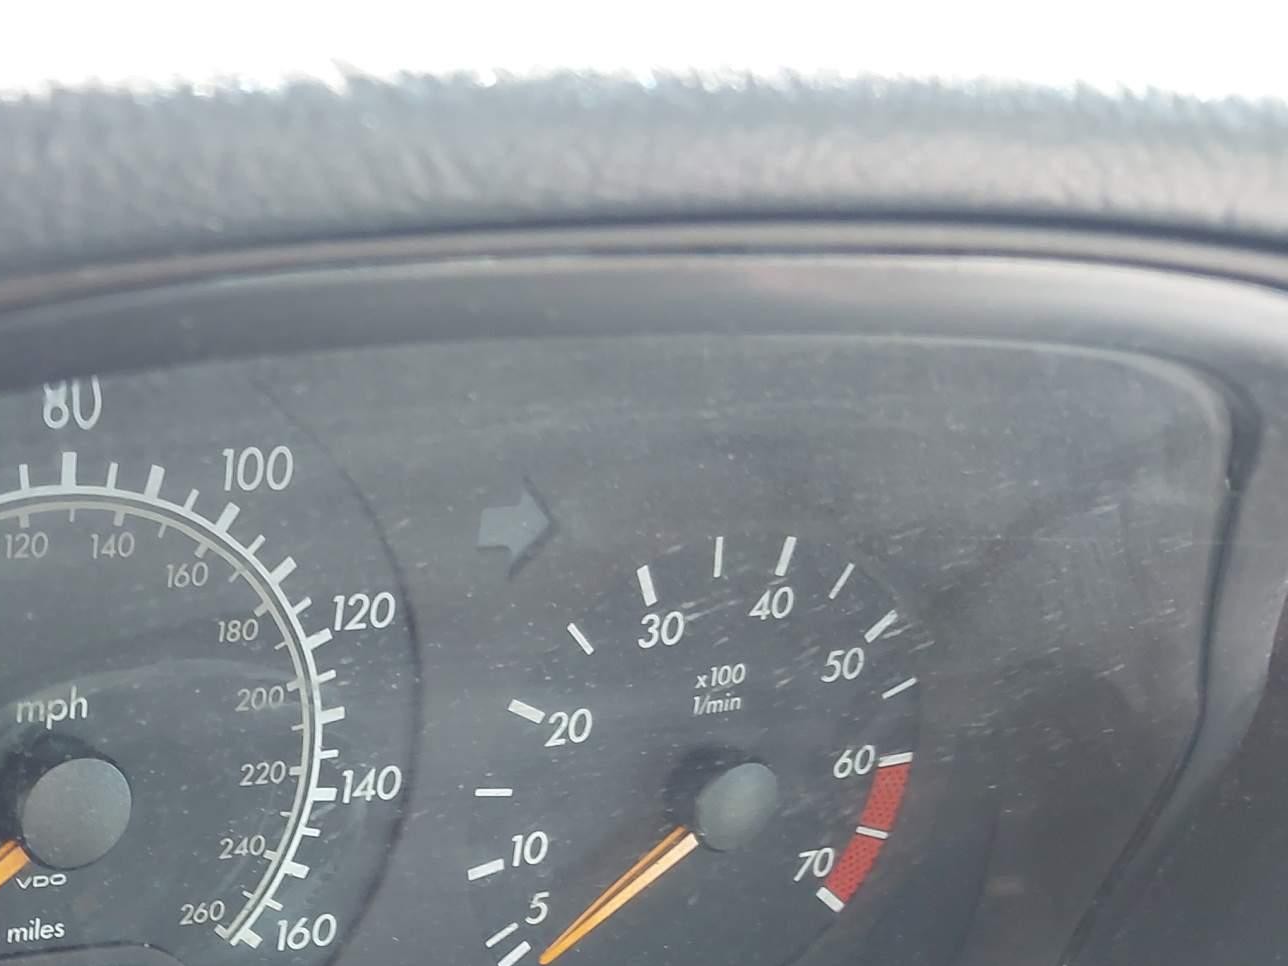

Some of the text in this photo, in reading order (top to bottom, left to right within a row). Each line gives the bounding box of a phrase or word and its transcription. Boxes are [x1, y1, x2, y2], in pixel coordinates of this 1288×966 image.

[42, 376, 102, 430] 80
[222, 446, 294, 491] 100
[4, 533, 48, 559] 120
[91, 533, 135, 558] 140
[166, 562, 208, 588] 160
[332, 592, 396, 632] 120
[748, 587, 794, 619] 40
[217, 617, 258, 643] 180
[637, 611, 684, 648] 30
[694, 663, 746, 688] x100
[821, 648, 865, 682] 50
[16, 687, 88, 728] mph
[235, 687, 285, 712] 200
[692, 692, 741, 715] 1/min
[544, 708, 592, 748] 20
[239, 760, 286, 786] 220
[833, 745, 875, 778] 60
[342, 766, 401, 803] 140
[219, 835, 266, 860] 240
[512, 831, 548, 866] 10
[794, 848, 834, 882] 70
[16, 873, 68, 889] VDO
[180, 900, 224, 926] 260
[525, 892, 549, 923] 5
[6, 918, 65, 944] miles
[277, 914, 336, 950] 160
